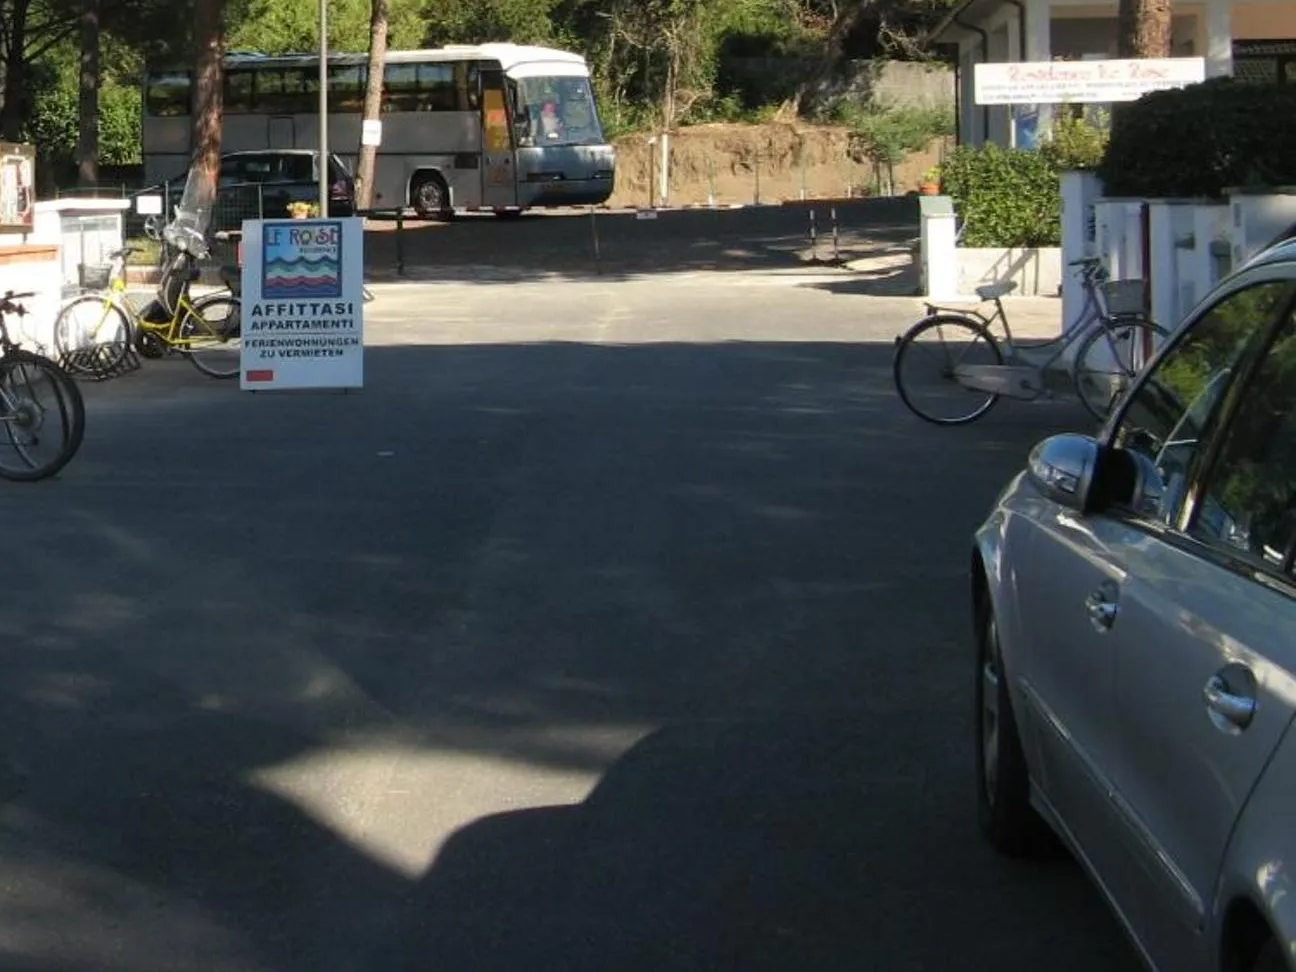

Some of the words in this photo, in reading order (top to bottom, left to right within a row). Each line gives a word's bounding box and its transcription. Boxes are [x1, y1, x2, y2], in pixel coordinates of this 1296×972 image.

[266, 229, 282, 246] LE
[290, 228, 338, 245] ROSE
[251, 303, 354, 317] AFFITTASI
[251, 319, 354, 330] APPARTAMENTI
[244, 337, 359, 348] FERIENWOHNUNGEN
[259, 350, 275, 358] ZU
[279, 349, 344, 358] VERMIETEN
